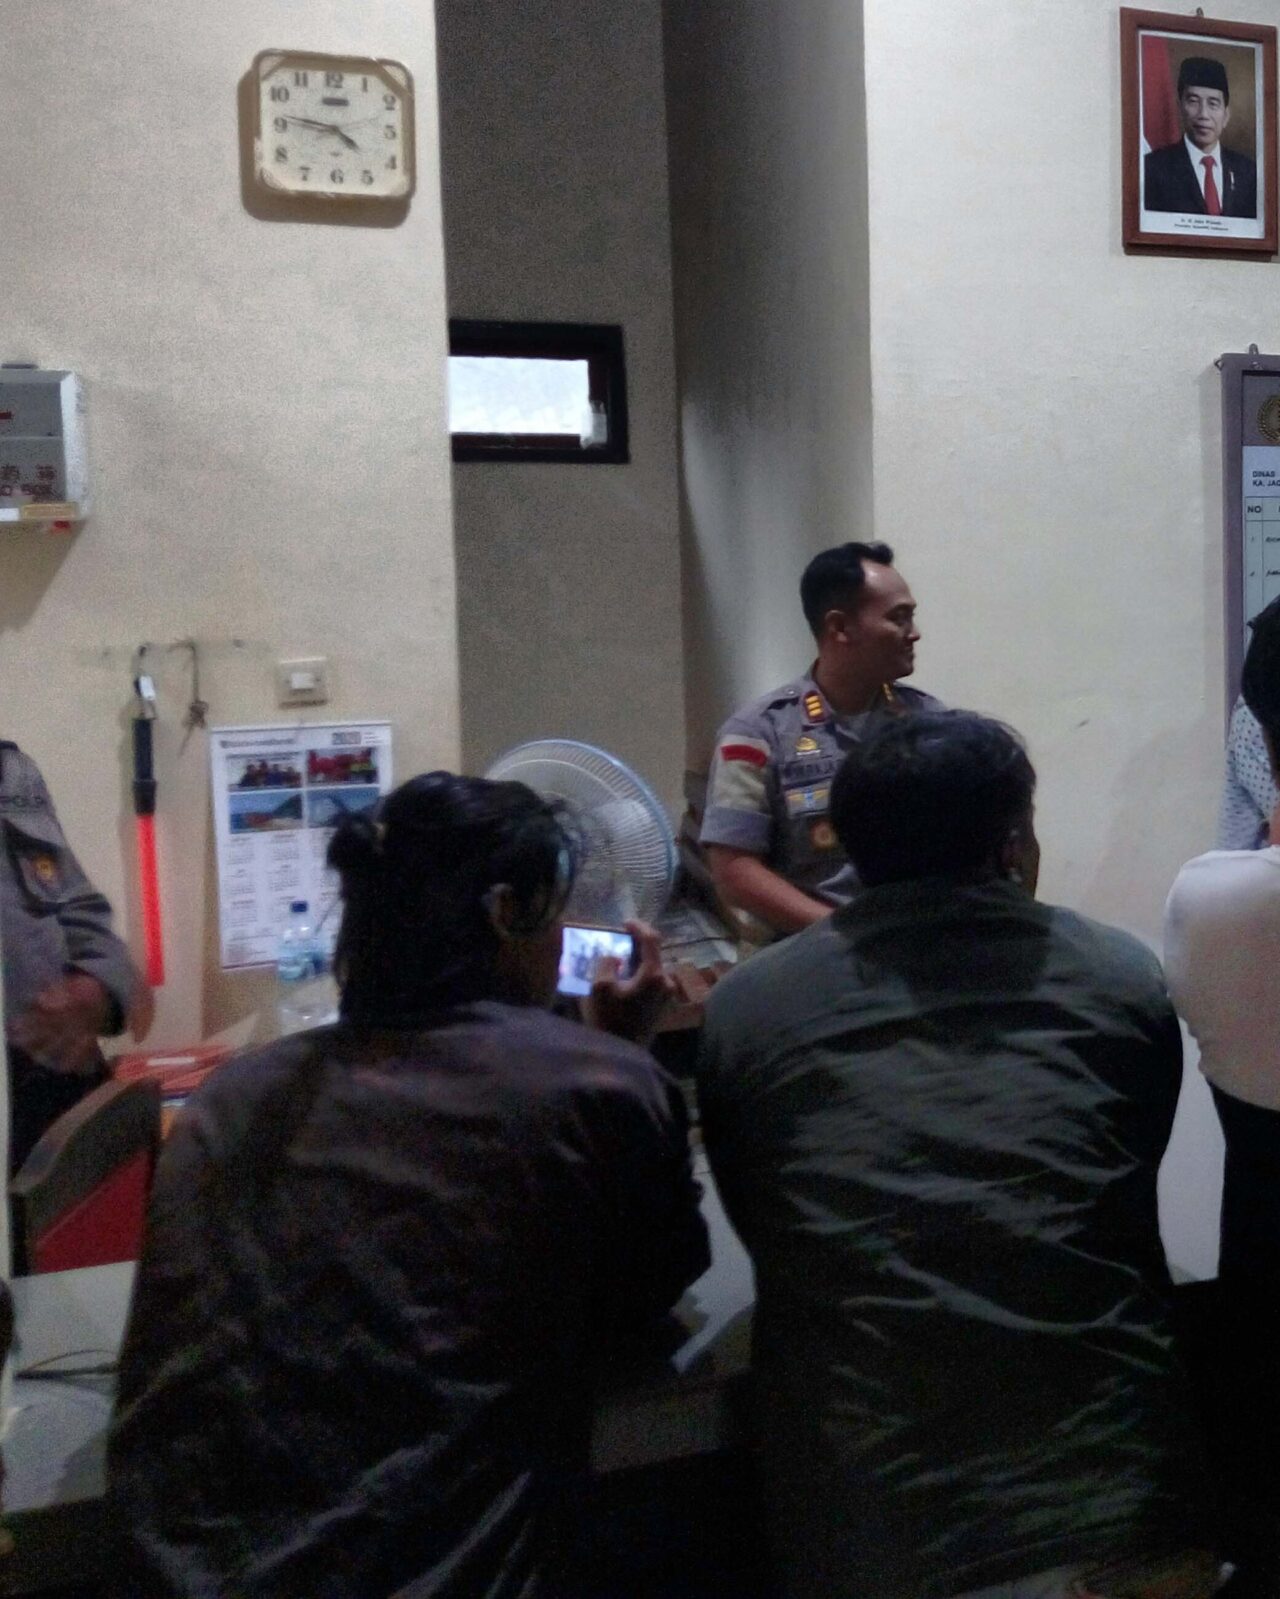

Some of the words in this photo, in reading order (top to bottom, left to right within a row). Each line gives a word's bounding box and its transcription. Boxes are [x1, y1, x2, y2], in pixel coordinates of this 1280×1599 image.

[294, 71, 308, 88] 11
[325, 71, 344, 89] 12
[362, 77, 368, 93] 1
[270, 86, 290, 103] 10
[383, 94, 396, 111] 2
[273, 117, 287, 133] 9
[384, 125, 396, 140] 3
[275, 146, 288, 163] 8
[384, 155, 397, 170] 4
[300, 166, 311, 181] 7
[330, 169, 344, 184] 6
[361, 169, 374, 185] 5
[1247, 505, 1262, 514] NO
